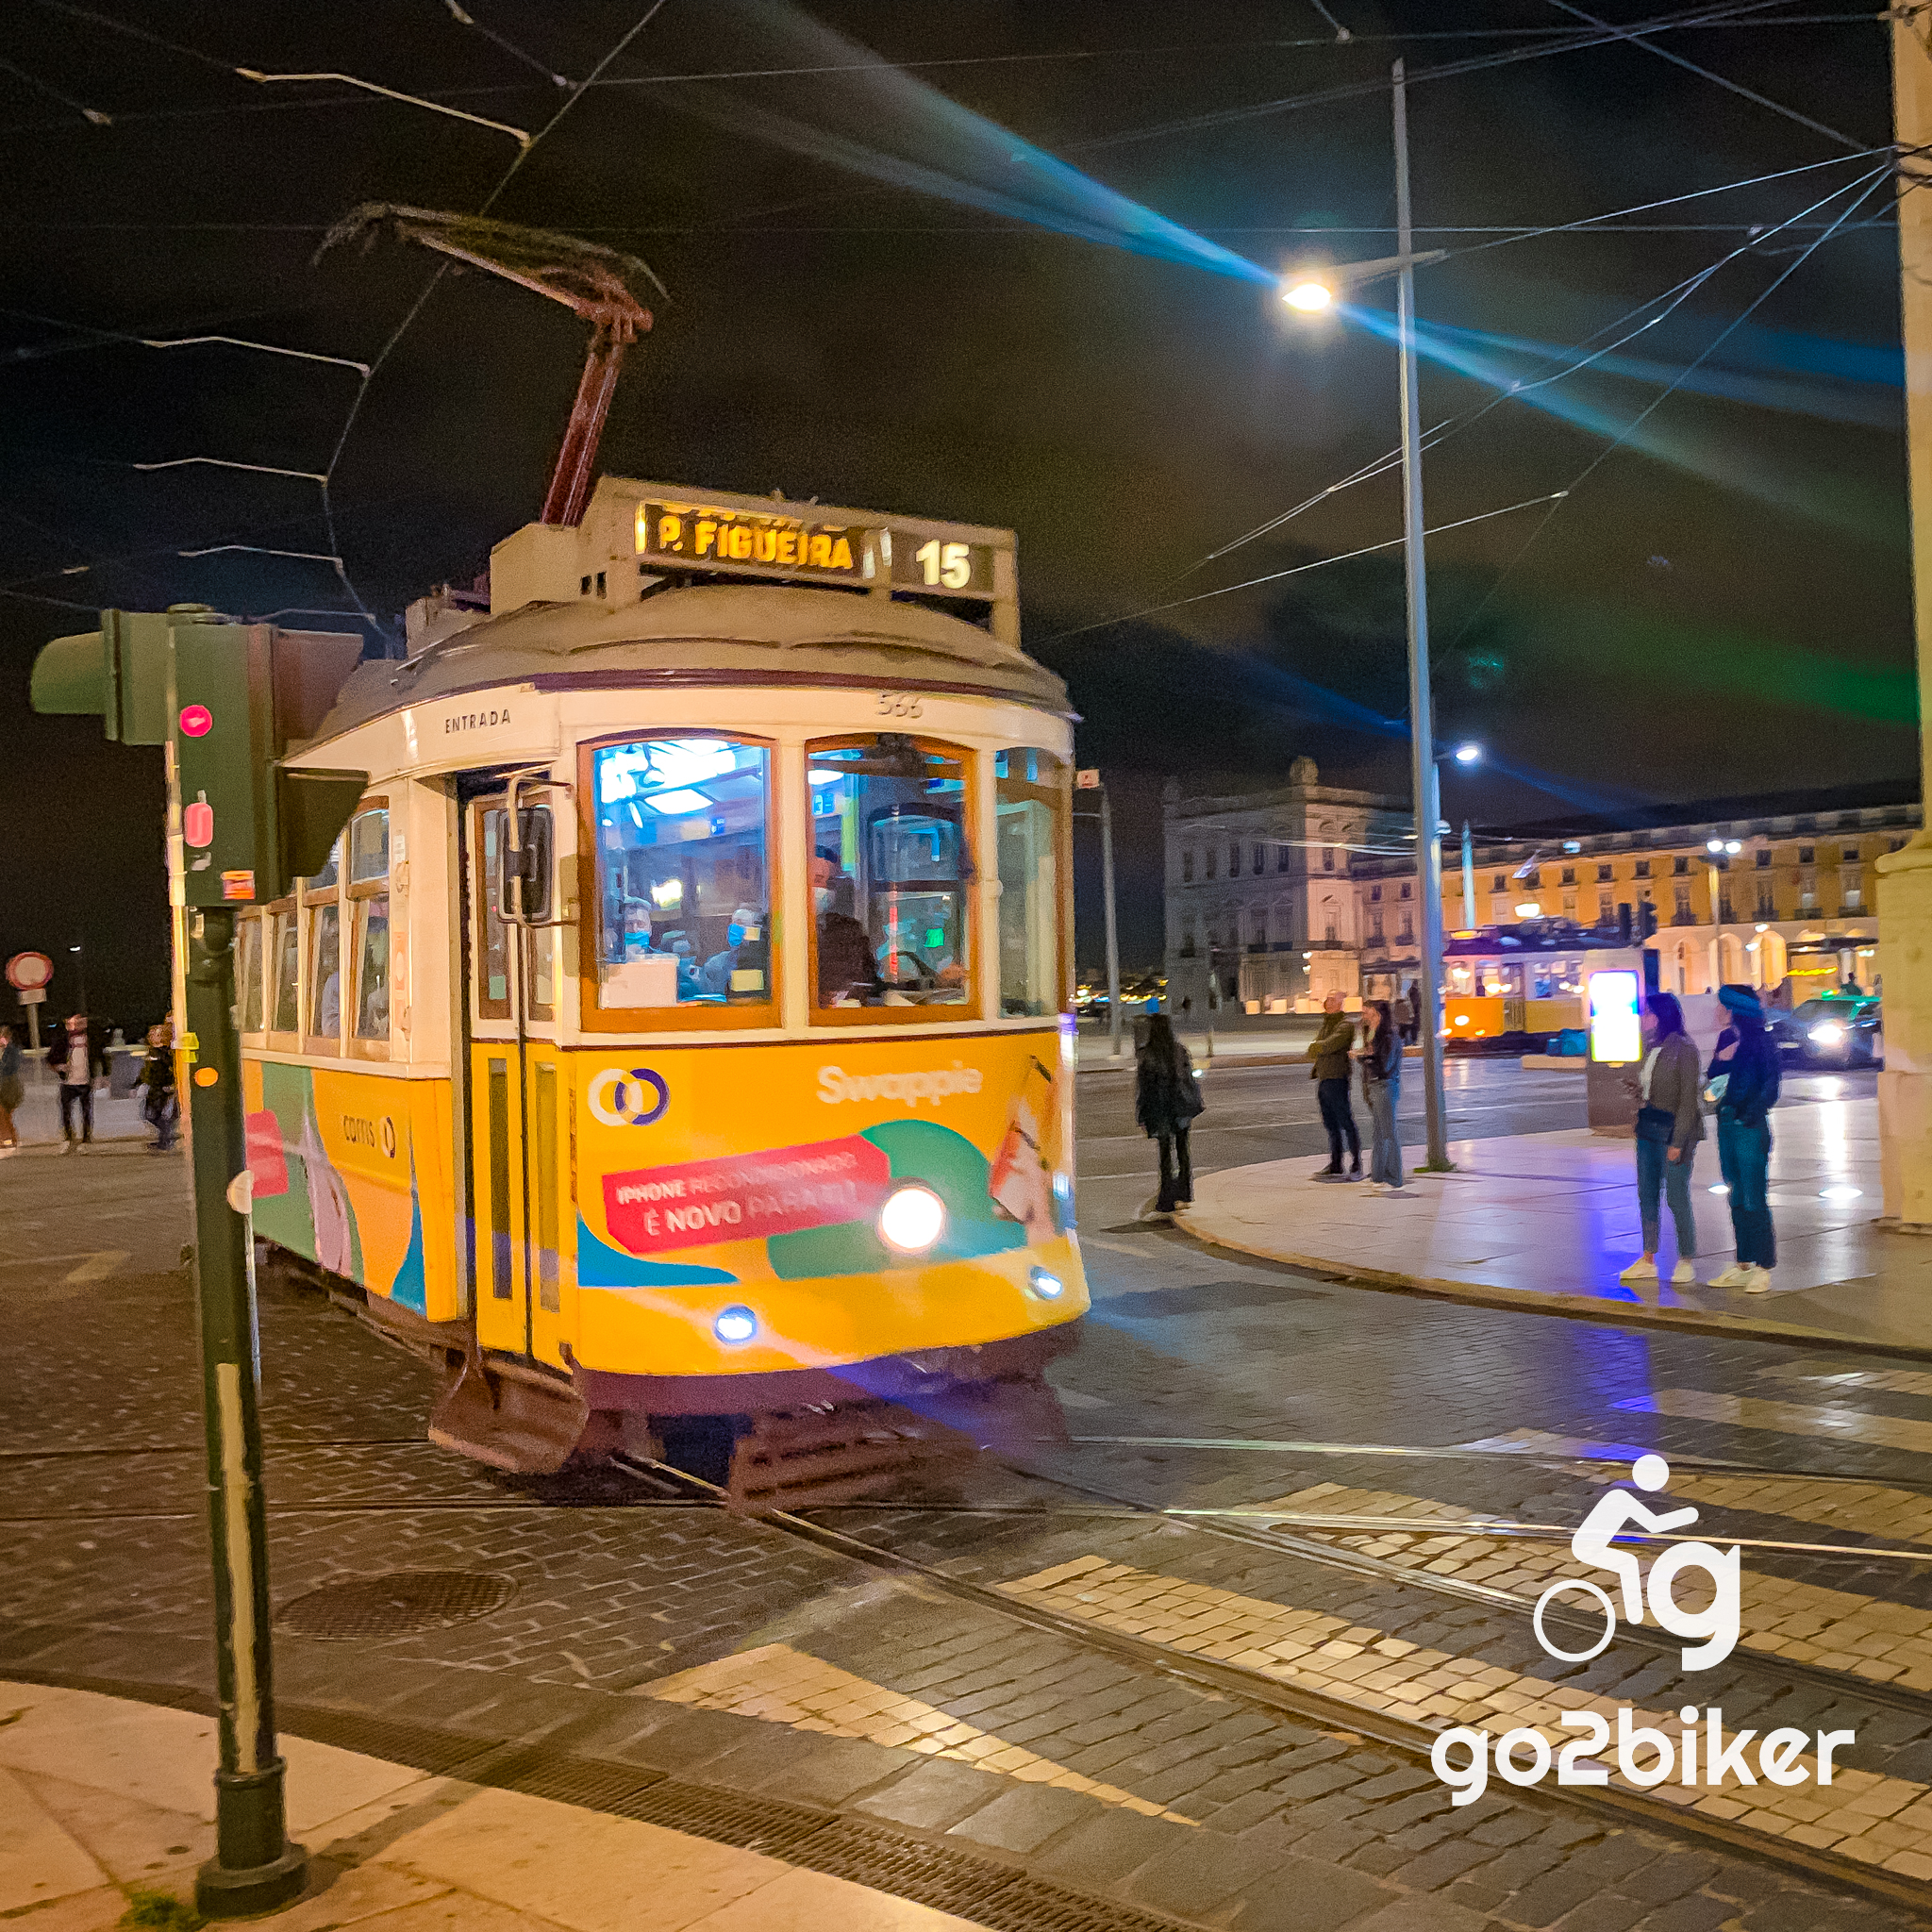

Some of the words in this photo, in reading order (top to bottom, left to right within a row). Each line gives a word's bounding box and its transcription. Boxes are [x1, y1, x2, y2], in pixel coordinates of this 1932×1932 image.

[658, 514, 684, 552] P.
[694, 519, 855, 570] FIGUEIRA
[916, 540, 971, 590] 15
[444, 708, 511, 734] ENTRADA
[816, 1059, 983, 1108] Swappie
[616, 1178, 687, 1206] IPHONE
[643, 1208, 660, 1236] É
[664, 1200, 741, 1233] NOVO
